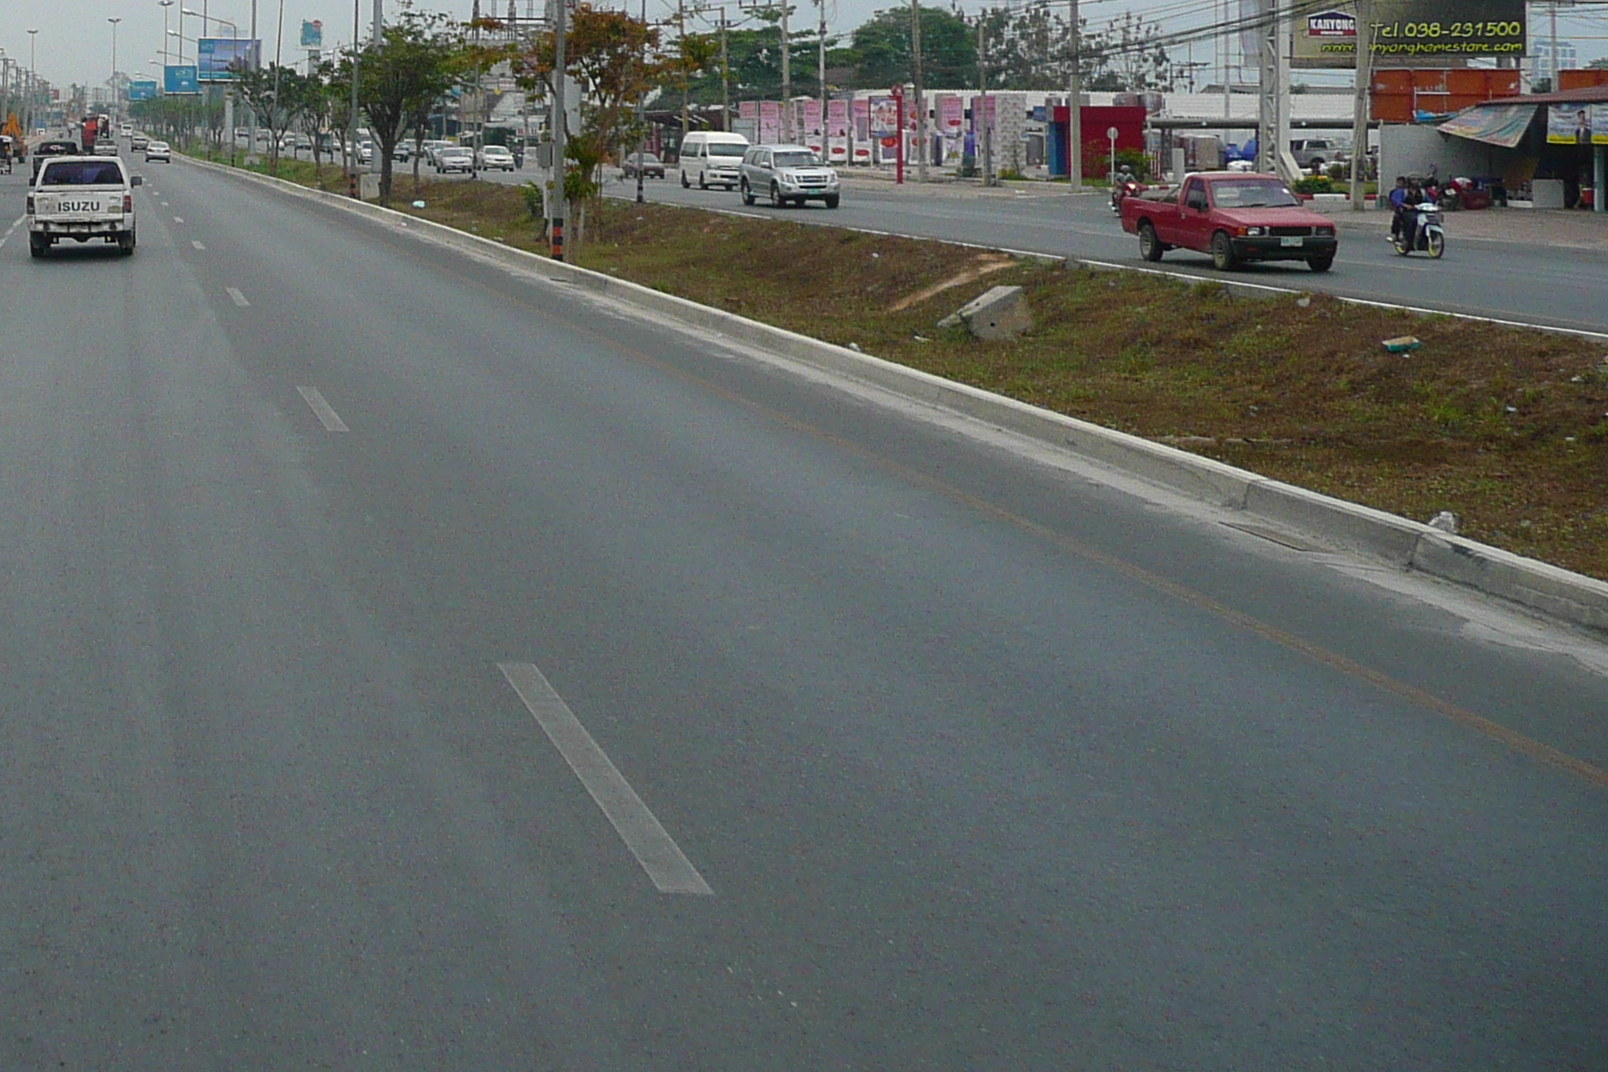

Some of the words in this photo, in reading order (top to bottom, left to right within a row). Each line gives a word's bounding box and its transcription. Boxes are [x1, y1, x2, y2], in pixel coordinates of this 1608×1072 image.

[1309, 18, 1355, 30] KANYONG
[1321, 41, 1523, 56] www.nyonghomestore.com
[58, 201, 100, 212] ISUZU
